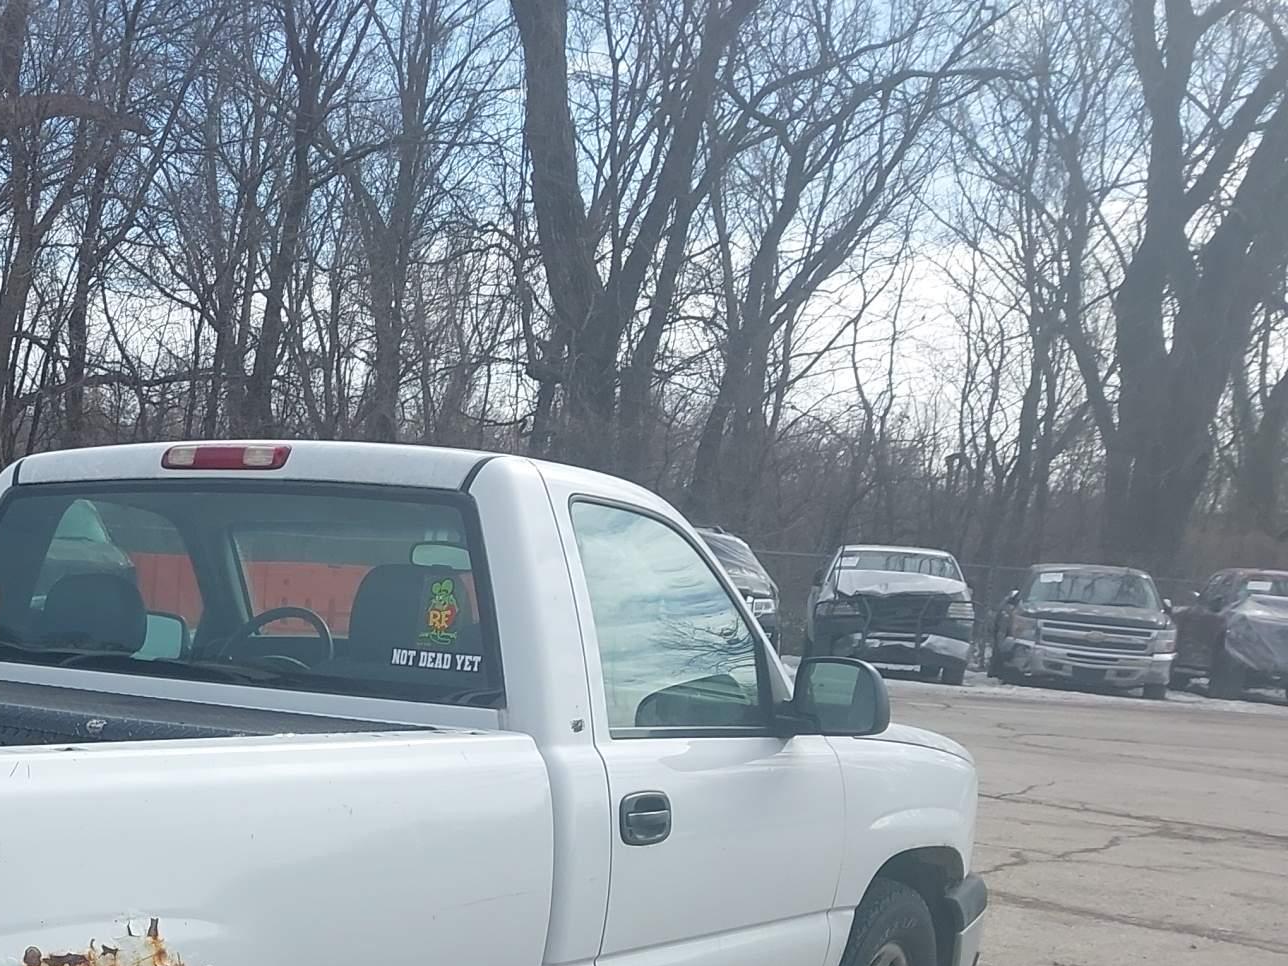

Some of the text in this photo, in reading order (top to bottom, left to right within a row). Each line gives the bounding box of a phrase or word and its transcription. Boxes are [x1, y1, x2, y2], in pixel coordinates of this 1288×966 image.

[392, 648, 482, 672] NOT DEAD YET
